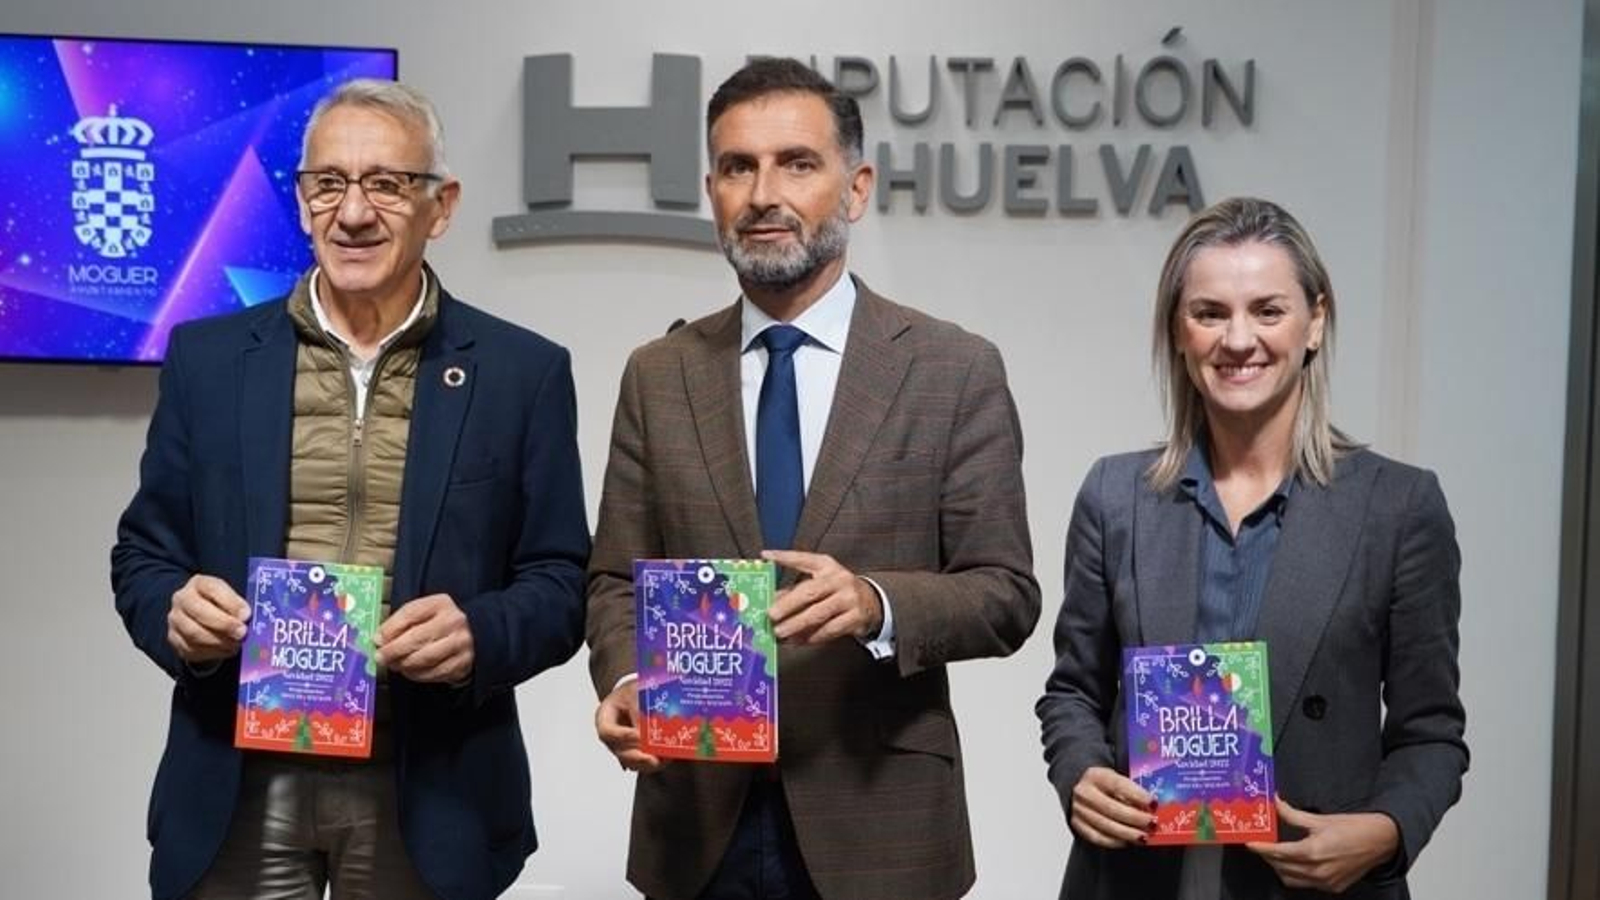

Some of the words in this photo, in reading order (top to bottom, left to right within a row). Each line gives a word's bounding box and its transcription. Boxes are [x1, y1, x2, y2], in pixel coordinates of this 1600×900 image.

[747, 27, 1256, 128] PUTACIÓN
[876, 142, 1206, 216] HUELVA
[69, 264, 158, 286] MOGUER
[274, 618, 348, 648] BRILLA
[666, 622, 743, 650] BRILLA
[271, 645, 345, 672] MOGUER
[666, 651, 743, 676] MOGUER
[1160, 705, 1238, 732] BRILLA
[1160, 733, 1239, 758] MOGUER
